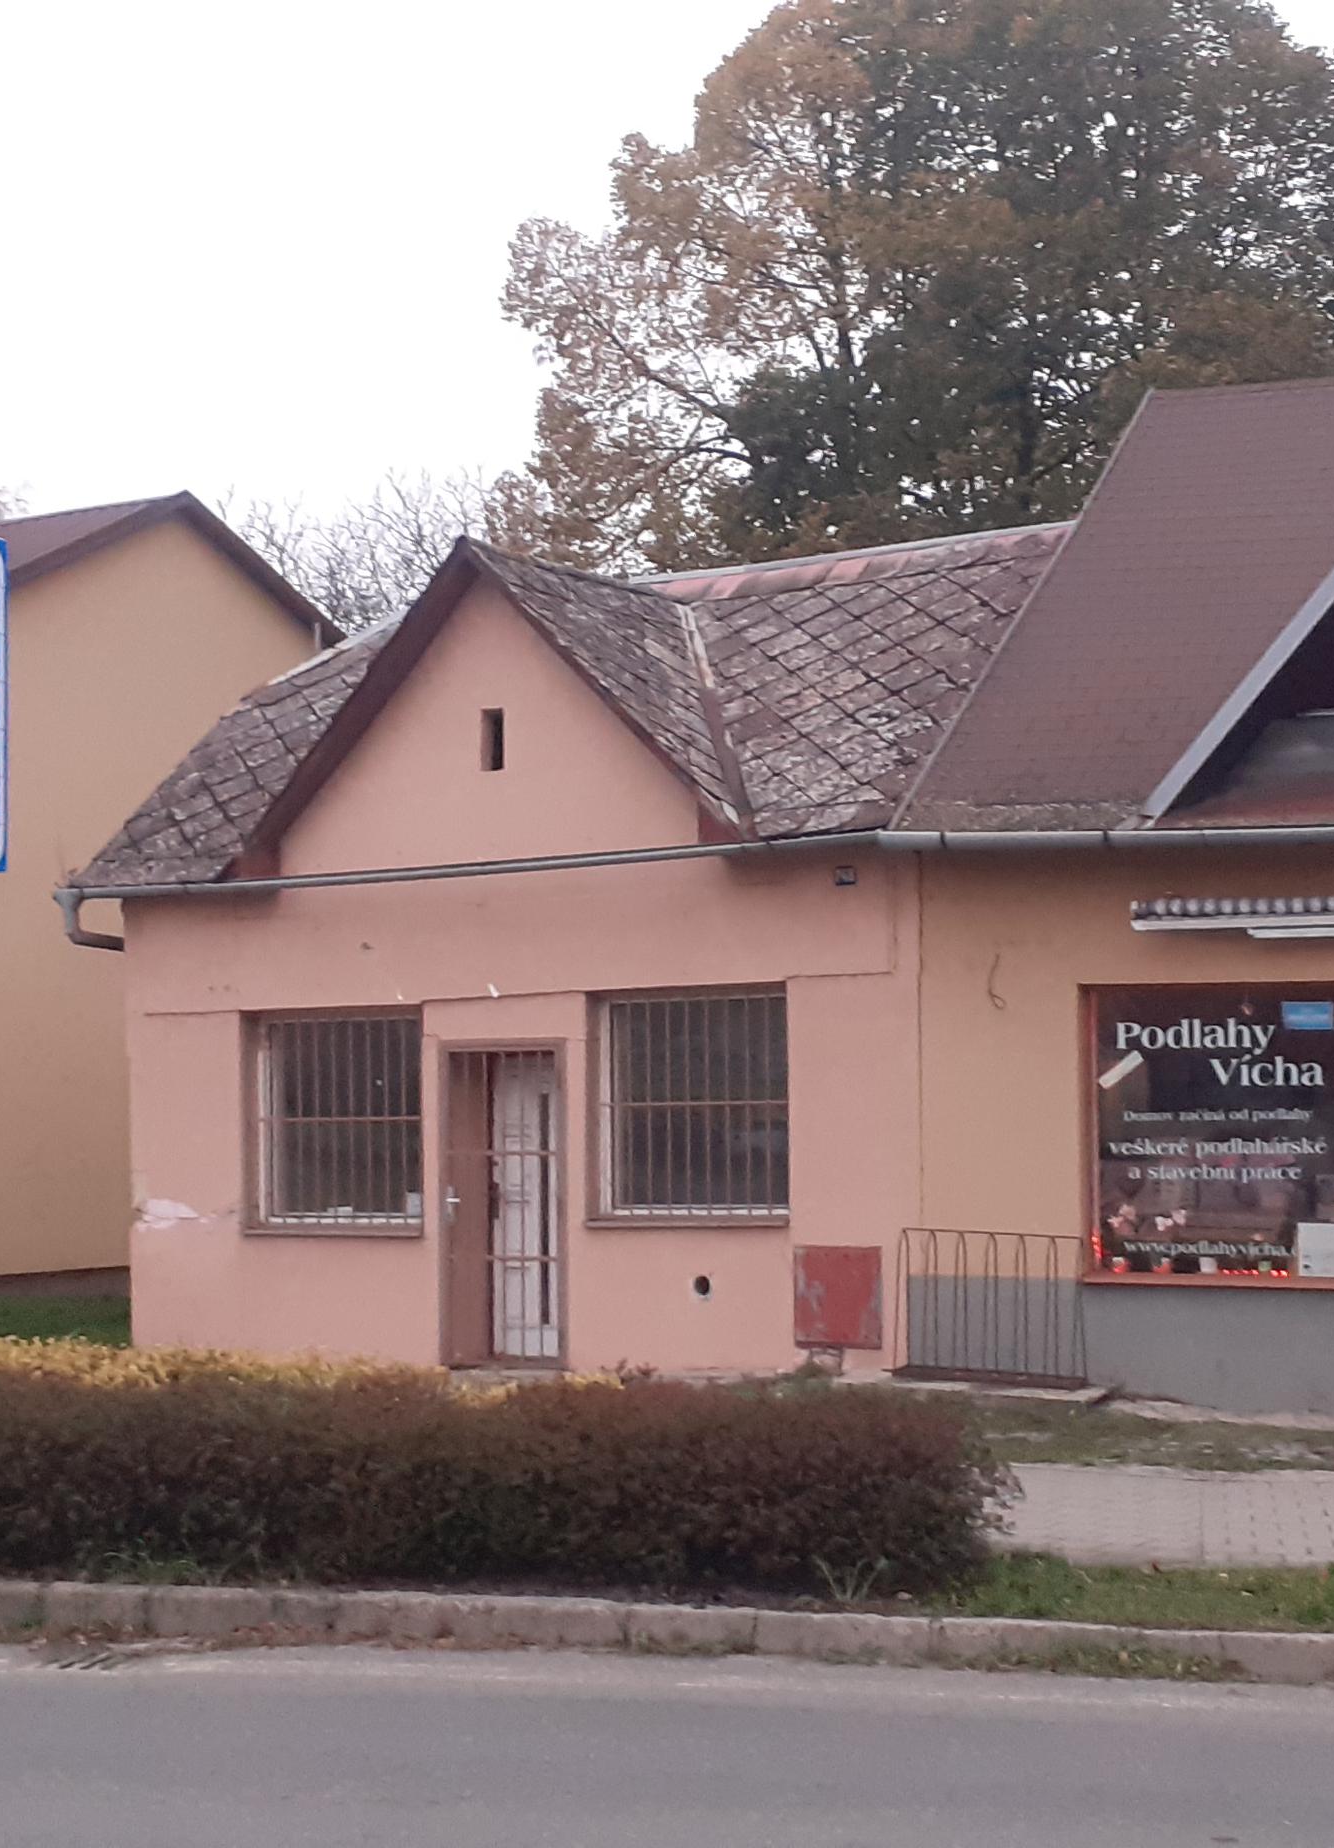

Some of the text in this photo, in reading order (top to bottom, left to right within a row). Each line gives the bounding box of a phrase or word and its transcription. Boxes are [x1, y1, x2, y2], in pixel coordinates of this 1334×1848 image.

[1116, 1018, 1276, 1055] Podlahy
[1209, 1054, 1325, 1087] Vícha
[1123, 1110, 1172, 1122] Domov
[1229, 1108, 1249, 1120] od
[1251, 1108, 1314, 1123] podlahy
[1108, 1137, 1189, 1156] veškeré
[1128, 1166, 1141, 1179] a
